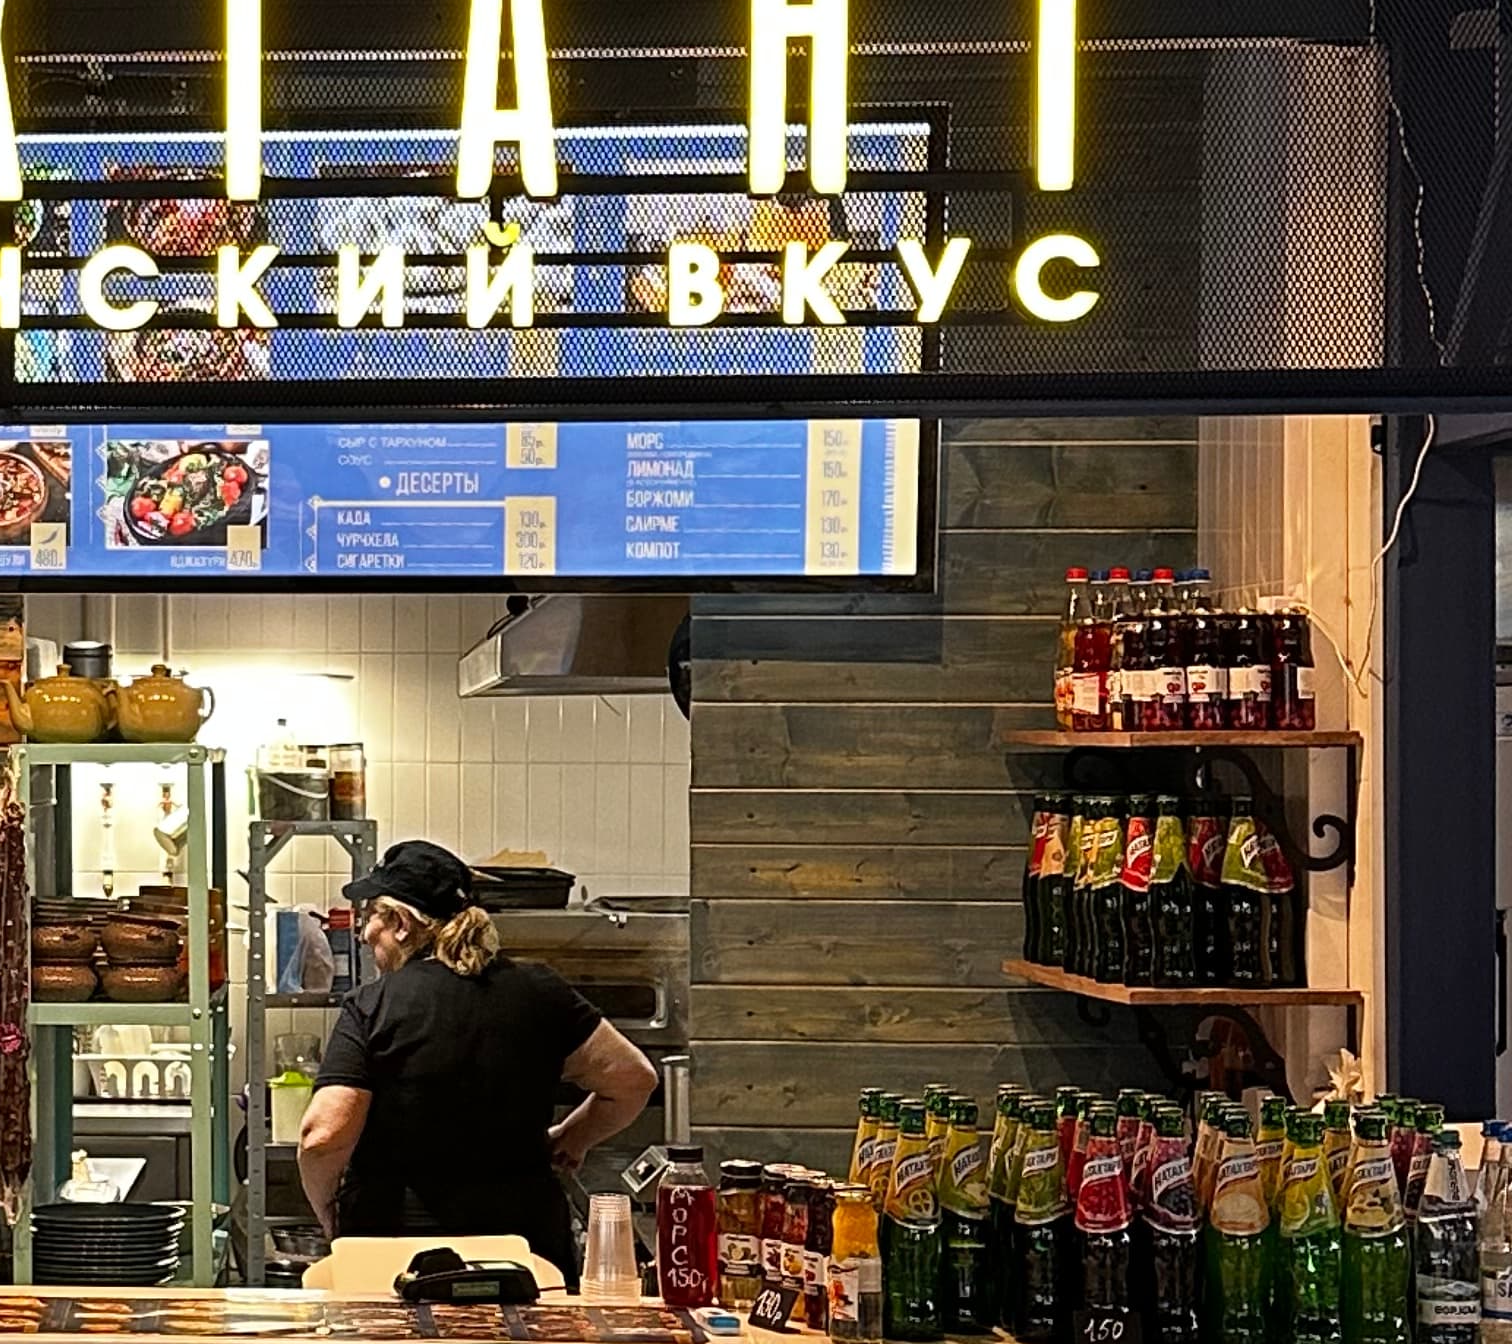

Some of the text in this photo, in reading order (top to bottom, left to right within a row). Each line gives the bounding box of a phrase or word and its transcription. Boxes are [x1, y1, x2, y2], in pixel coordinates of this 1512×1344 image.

[668, 234, 1100, 327] ВКУС
[626, 432, 664, 450] МОРС
[627, 460, 695, 479] ЛИМОНАД
[396, 471, 480, 496] ДЕСЕРТЫ
[626, 490, 694, 507] БОРЖОМИ
[337, 511, 371, 526] КАДА
[626, 542, 681, 560] КОМПОТ
[1084, 1318, 1124, 1342] 150
